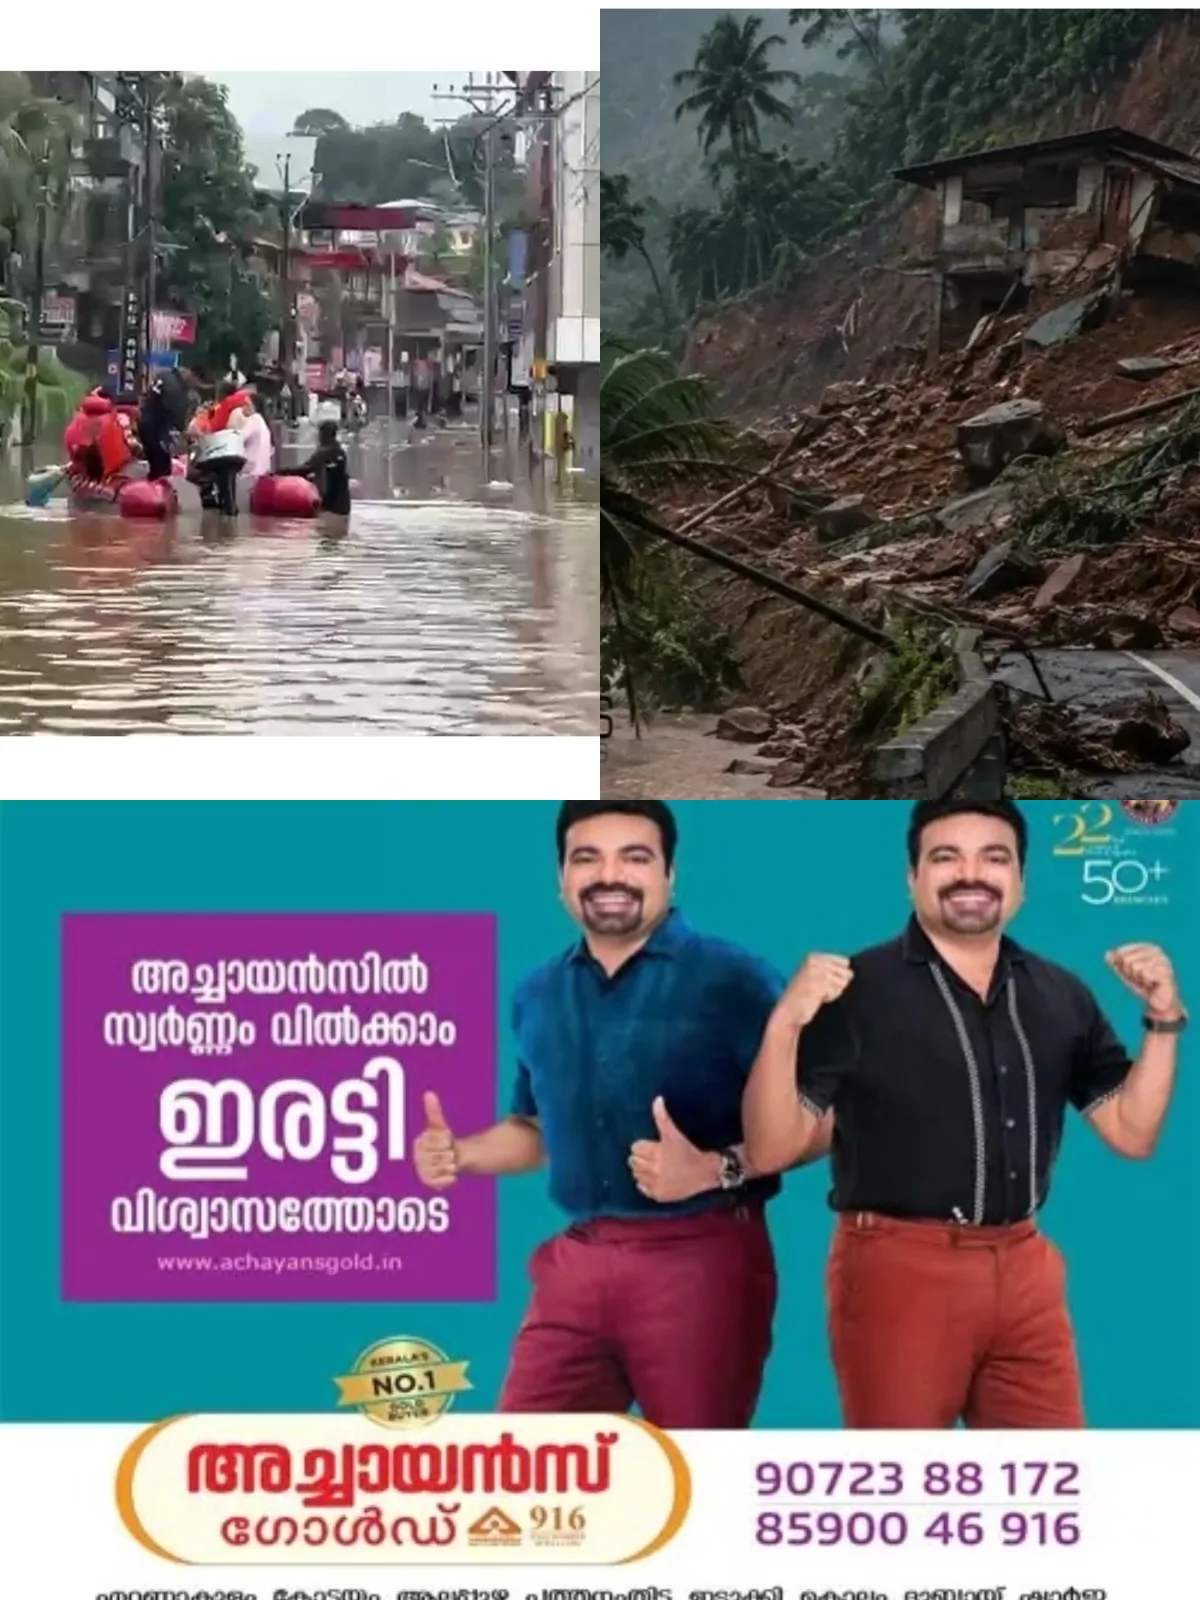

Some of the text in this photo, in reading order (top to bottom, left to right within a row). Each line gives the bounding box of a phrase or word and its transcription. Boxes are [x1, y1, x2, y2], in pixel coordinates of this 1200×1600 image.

[1053, 802, 1112, 856] 22
[1081, 859, 1168, 905] 50+
[131, 951, 428, 1003] അച്ചായൻസിൽ
[104, 1003, 456, 1055] സ്വർണ്ണം വിൽക്കാം
[159, 1056, 406, 1184] ഇരട്ടി
[111, 1187, 450, 1239] വിശ്വാസത്തോടെ
[158, 1253, 403, 1275] www.achayansgold.in
[372, 1370, 436, 1397] NO.1
[187, 1433, 619, 1507] അച്ചായൻസ്
[755, 1462, 1080, 1495] 90723 88 172
[220, 1503, 462, 1546] ഗോൾഡ്
[529, 1505, 586, 1531] 916
[755, 1512, 1080, 1546] 85900 46 916
